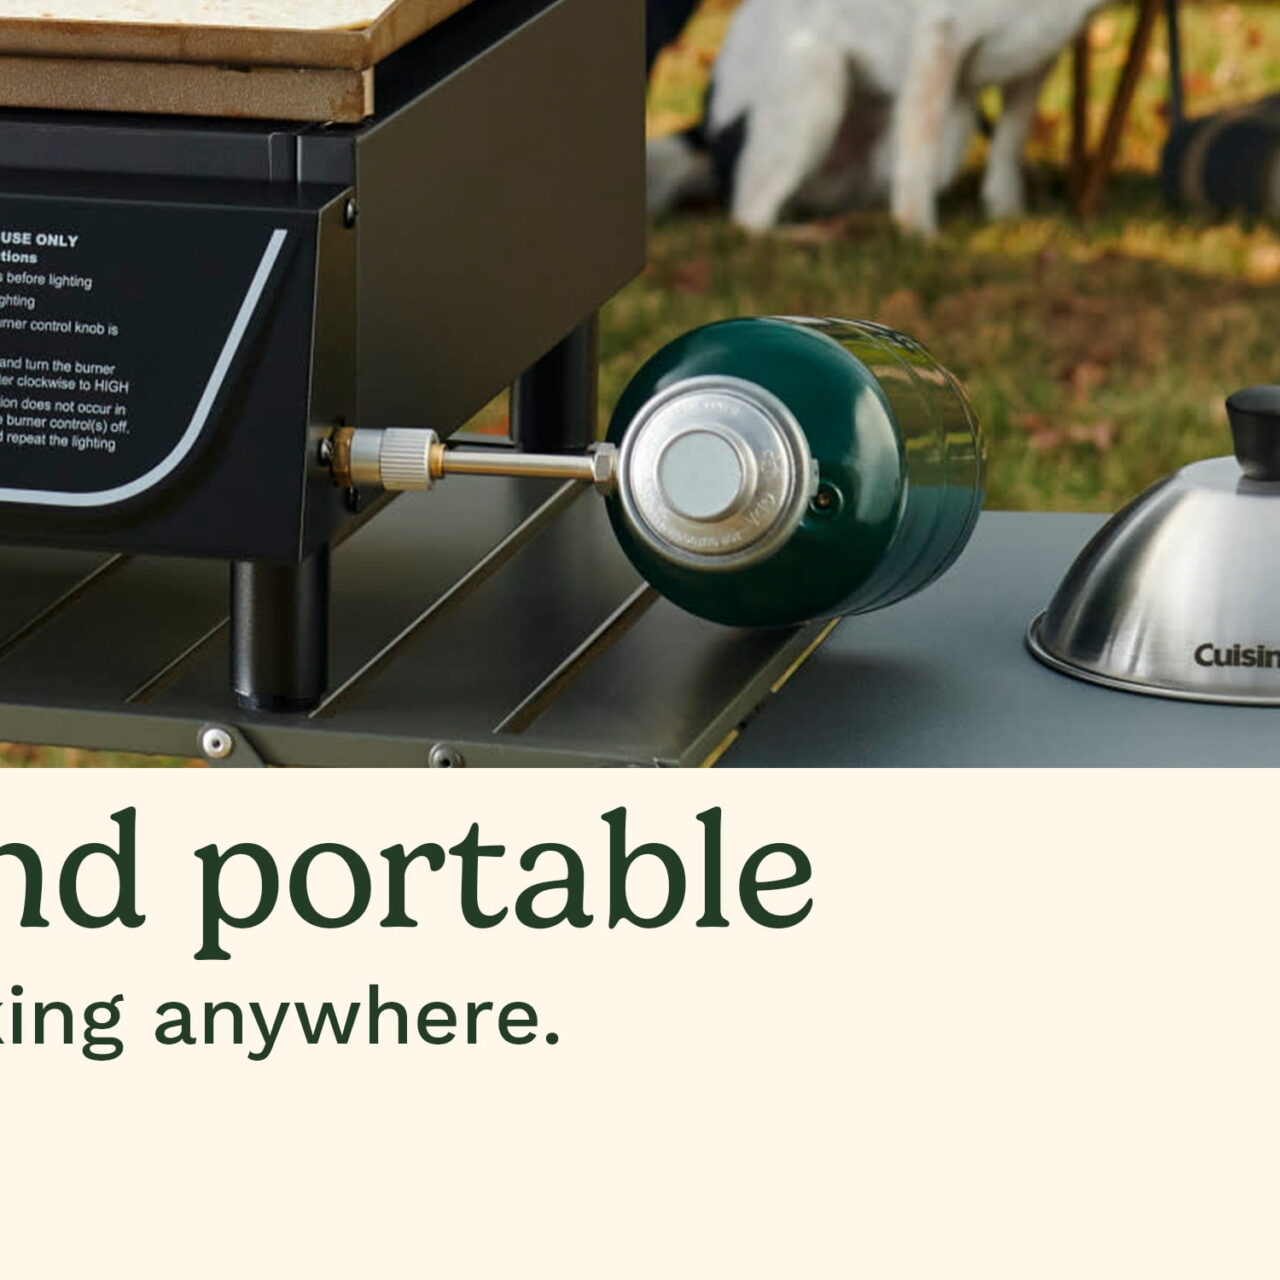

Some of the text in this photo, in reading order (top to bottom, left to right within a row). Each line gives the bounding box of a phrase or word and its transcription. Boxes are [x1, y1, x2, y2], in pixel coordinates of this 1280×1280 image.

[1, 231, 32, 245] USE
[36, 234, 78, 247] ONLY
[7, 272, 46, 285] before
[49, 274, 92, 290] lighting
[30, 319, 71, 332] control
[75, 322, 105, 335] knob
[108, 324, 119, 336] is
[0, 357, 22, 369] and
[25, 359, 48, 371] turn
[52, 360, 71, 372] the
[75, 362, 115, 375] burner
[17, 374, 76, 389] clockwise
[79, 380, 91, 391] to
[95, 380, 129, 393] HIGH
[22, 397, 51, 411] does
[55, 400, 75, 412] not
[78, 402, 112, 414] occur
[115, 403, 126, 415] in
[7, 414, 46, 427] burner
[49, 417, 107, 433] control(s)
[7, 432, 46, 446] repeat
[49, 433, 69, 447] the
[72, 434, 116, 453] lighting
